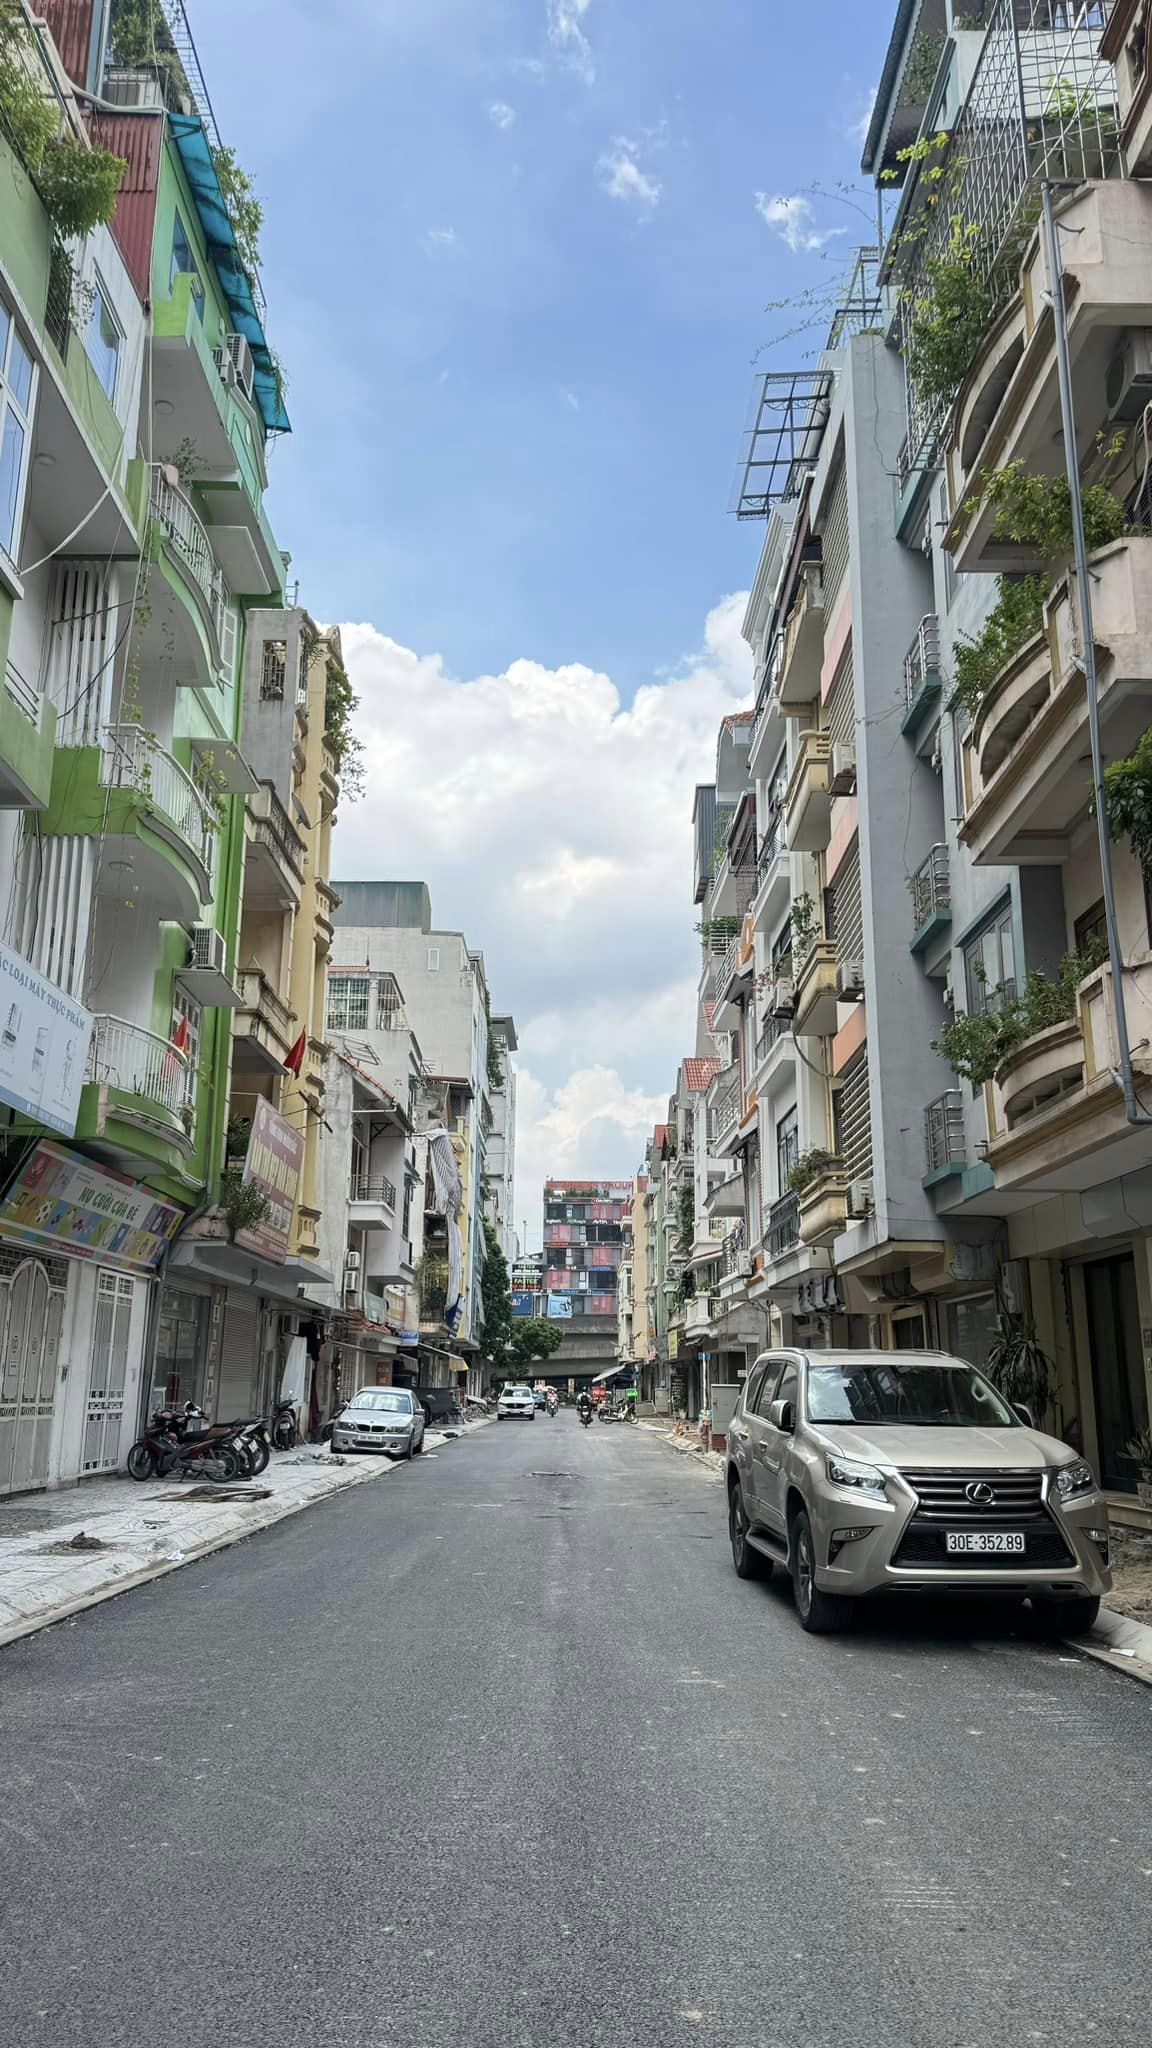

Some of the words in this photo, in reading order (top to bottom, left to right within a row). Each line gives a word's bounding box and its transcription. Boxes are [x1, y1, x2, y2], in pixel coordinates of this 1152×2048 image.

[9, 964, 28, 988] LOẠI
[28, 979, 46, 1001] MÁY
[47, 993, 66, 1015] THỰC
[949, 1534, 1023, 1551] 30E-352.89
